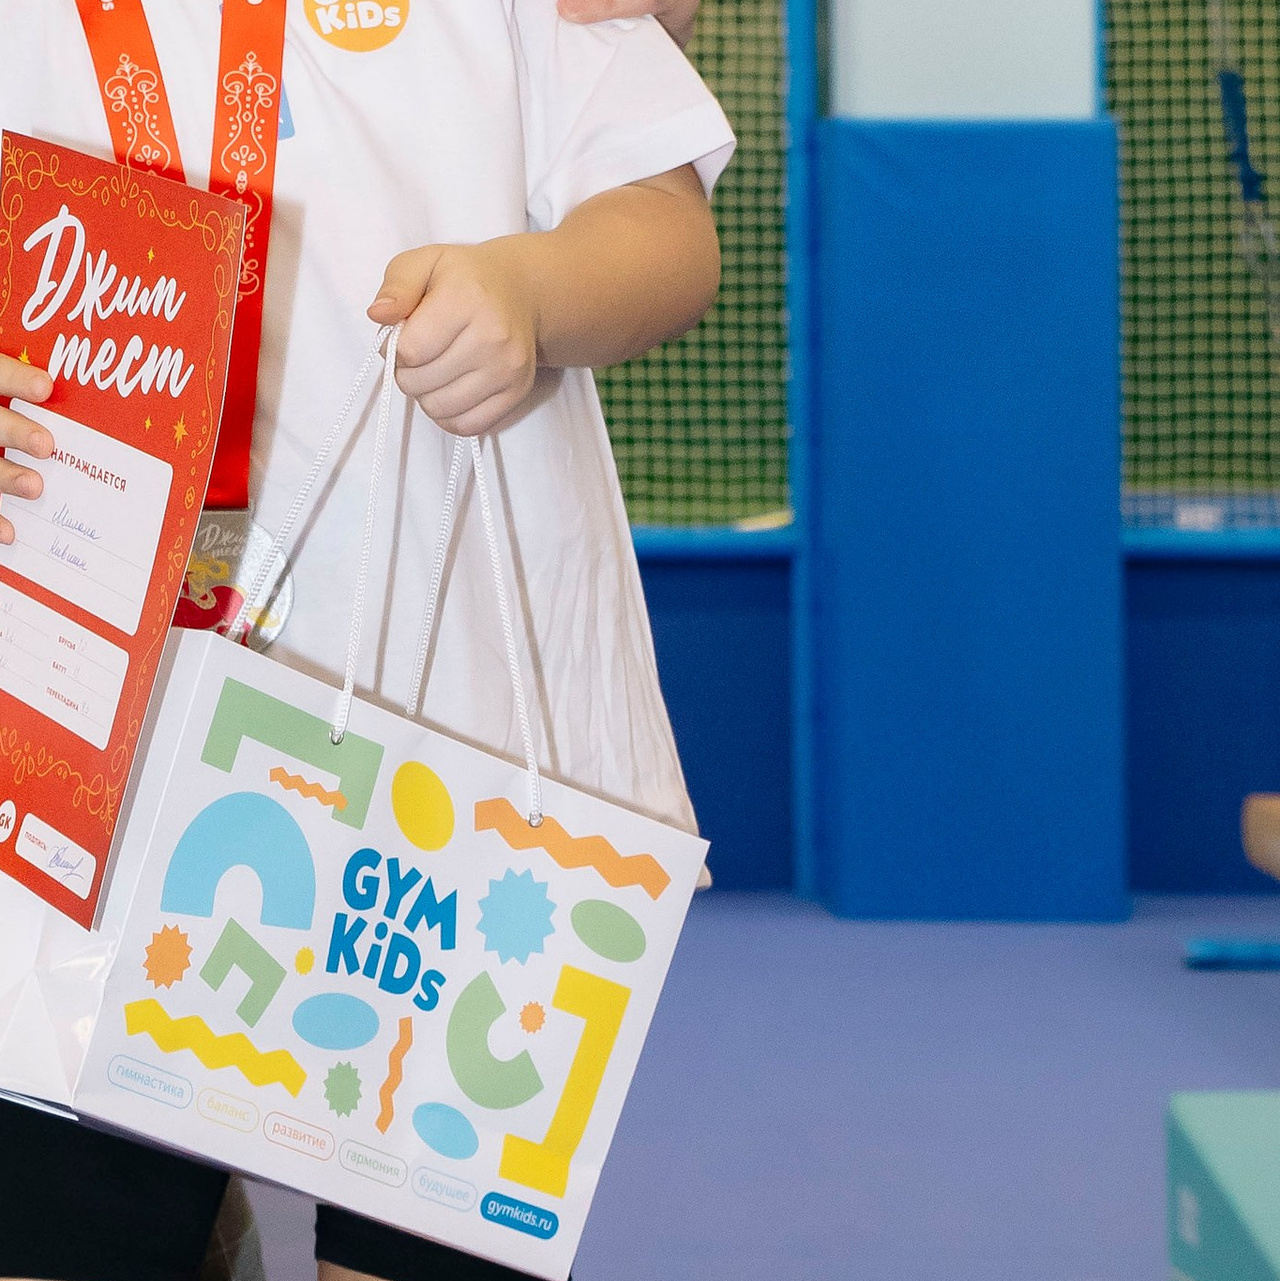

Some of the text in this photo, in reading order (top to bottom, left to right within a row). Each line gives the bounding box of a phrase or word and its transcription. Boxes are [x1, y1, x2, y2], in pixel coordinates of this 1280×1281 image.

[21, 203, 187, 331] Джим
[48, 332, 195, 399] тест
[50, 447, 127, 492] НАГРАЖДАЕТСЯ
[342, 847, 458, 951] GYM
[116, 1064, 185, 1099] гимнастика
[206, 1095, 251, 1122] баланс
[271, 1121, 327, 1150] развитие
[345, 1148, 401, 1177] гармония
[419, 1174, 470, 1202] будущее
[487, 1199, 553, 1232] gymkids.ru
